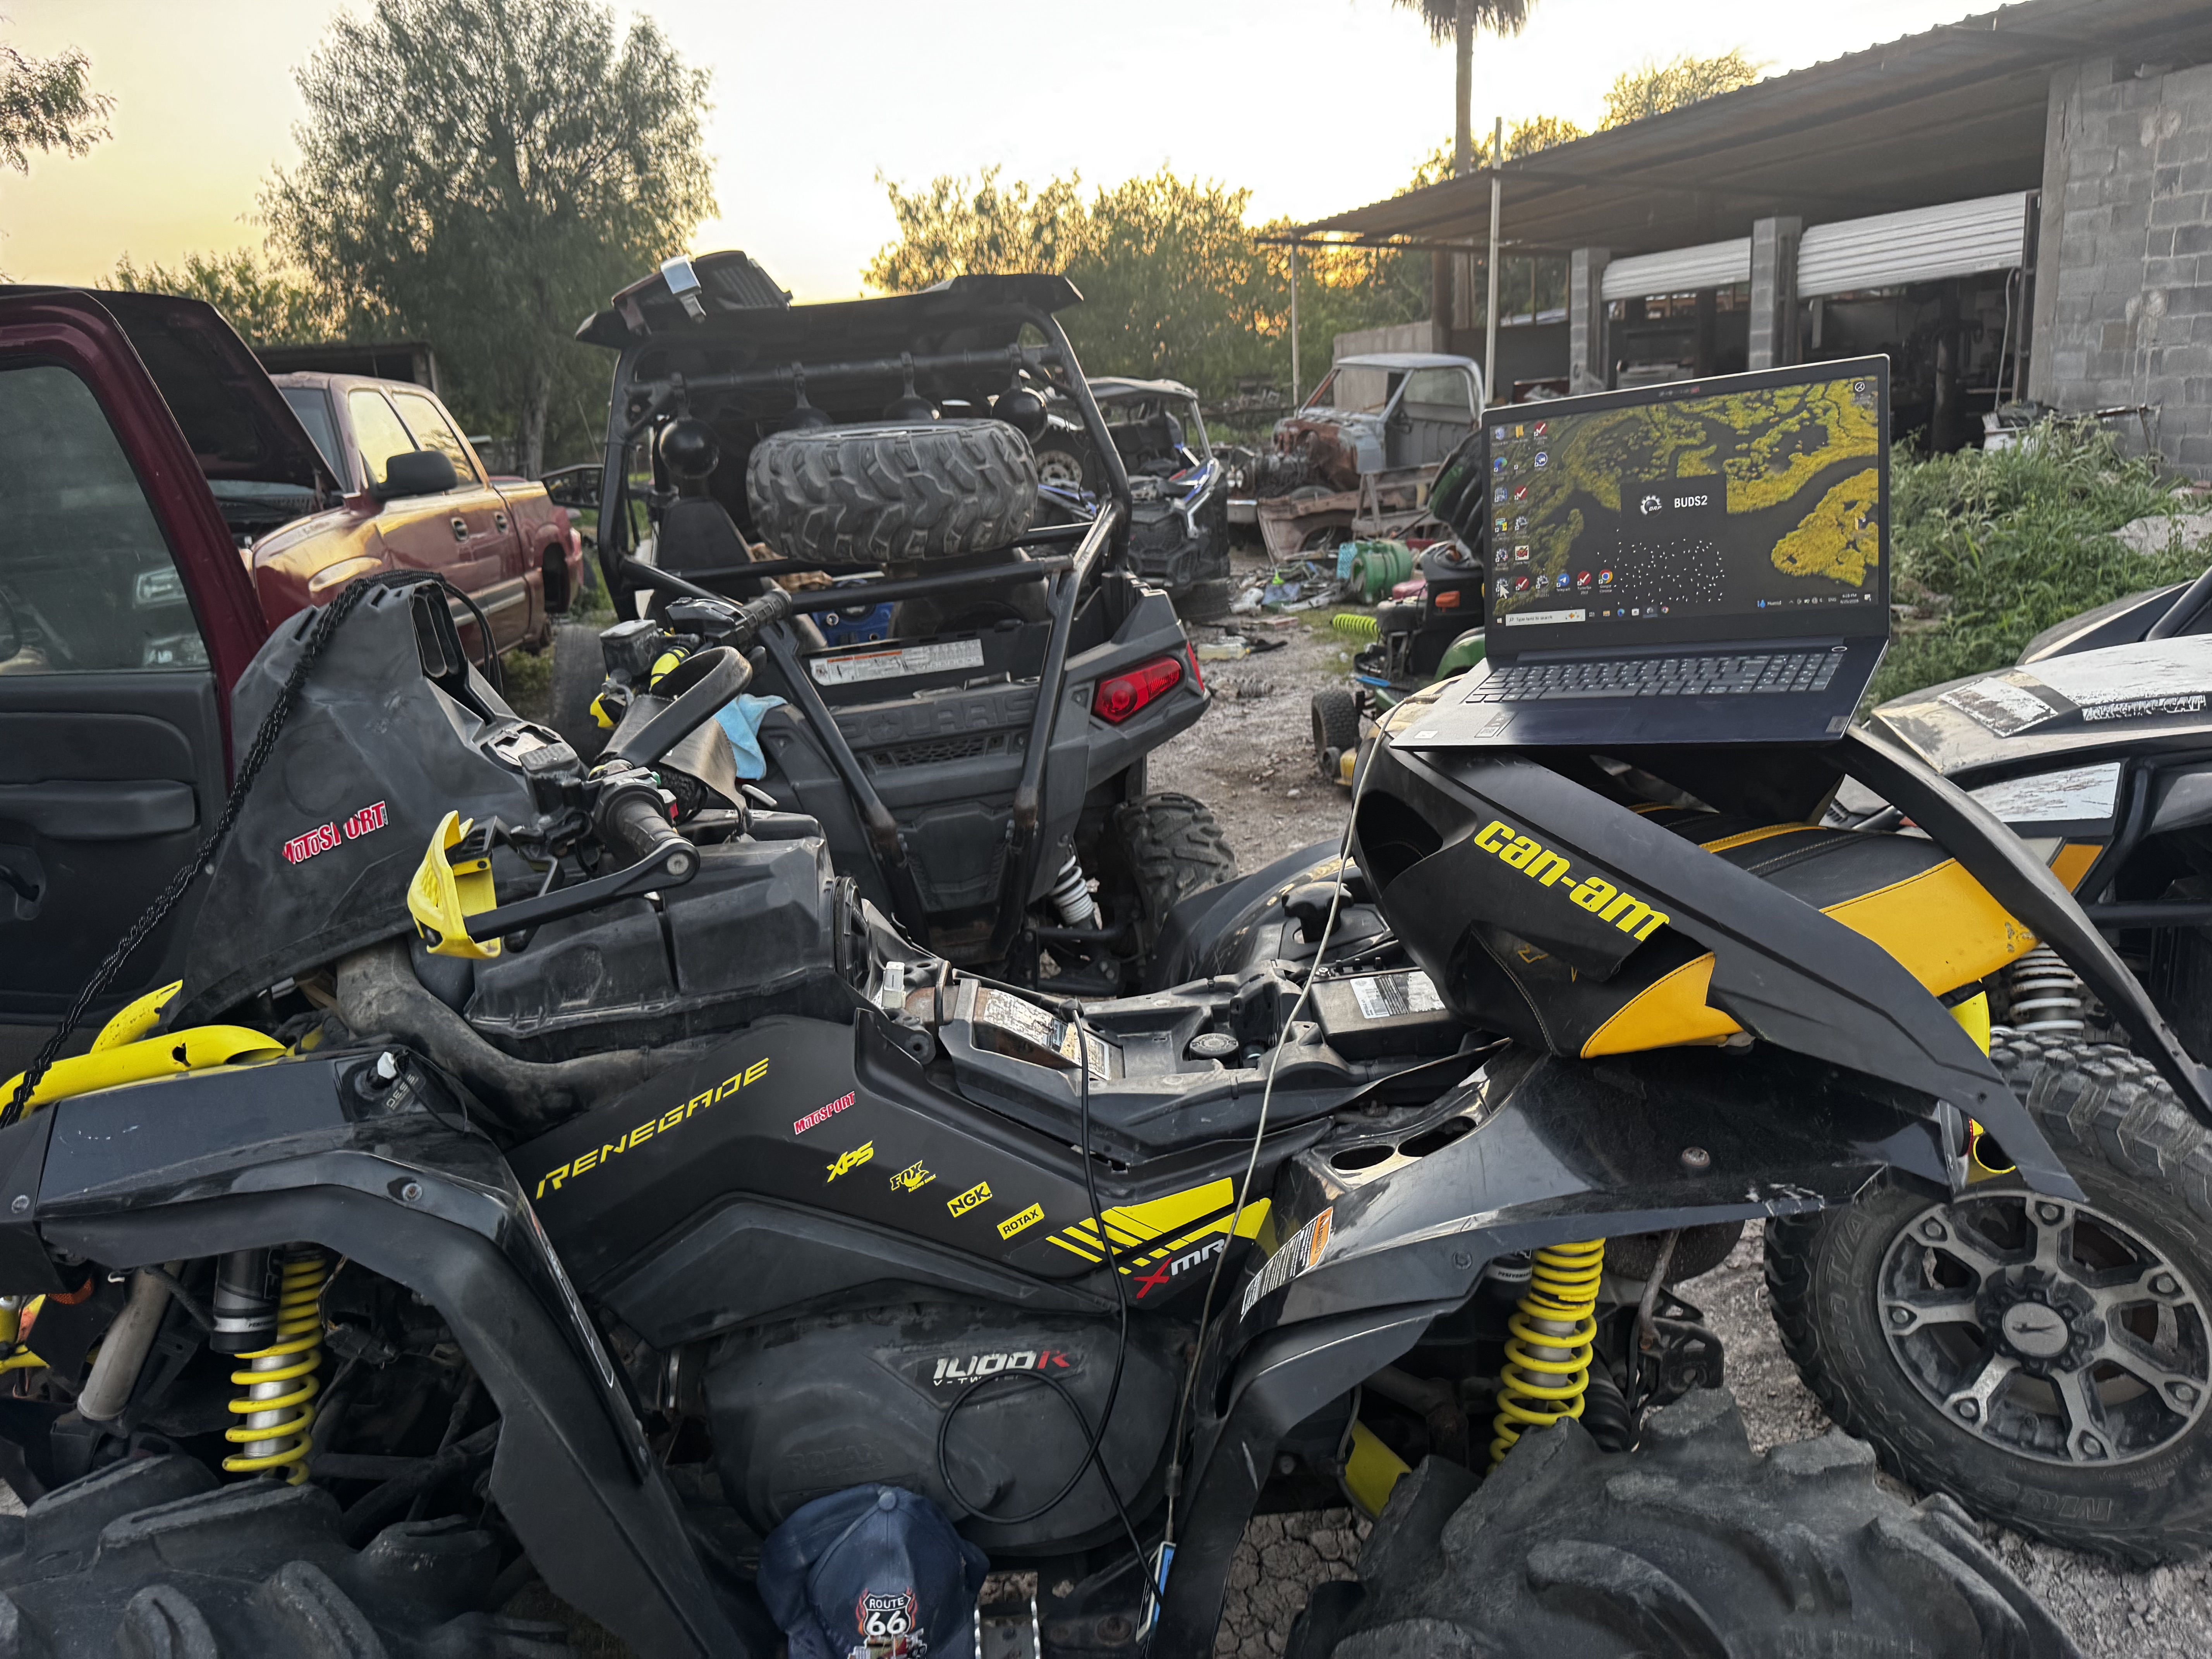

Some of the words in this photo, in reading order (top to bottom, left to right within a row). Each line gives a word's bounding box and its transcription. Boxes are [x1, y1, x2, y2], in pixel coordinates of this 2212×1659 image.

[1674, 495, 1708, 508] BUDS2
[833, 691, 1034, 742] POLARIS
[1474, 820, 1670, 942] can-am
[536, 1057, 769, 1200] RENEGADE
[827, 1140, 874, 1183] XPS
[890, 1160, 927, 1191] FOX
[950, 1185, 990, 1214] NGK
[1002, 1209, 1039, 1235] ROTAX
[869, 1597, 904, 1608] ROUTE
[866, 1610, 907, 1636] 66
